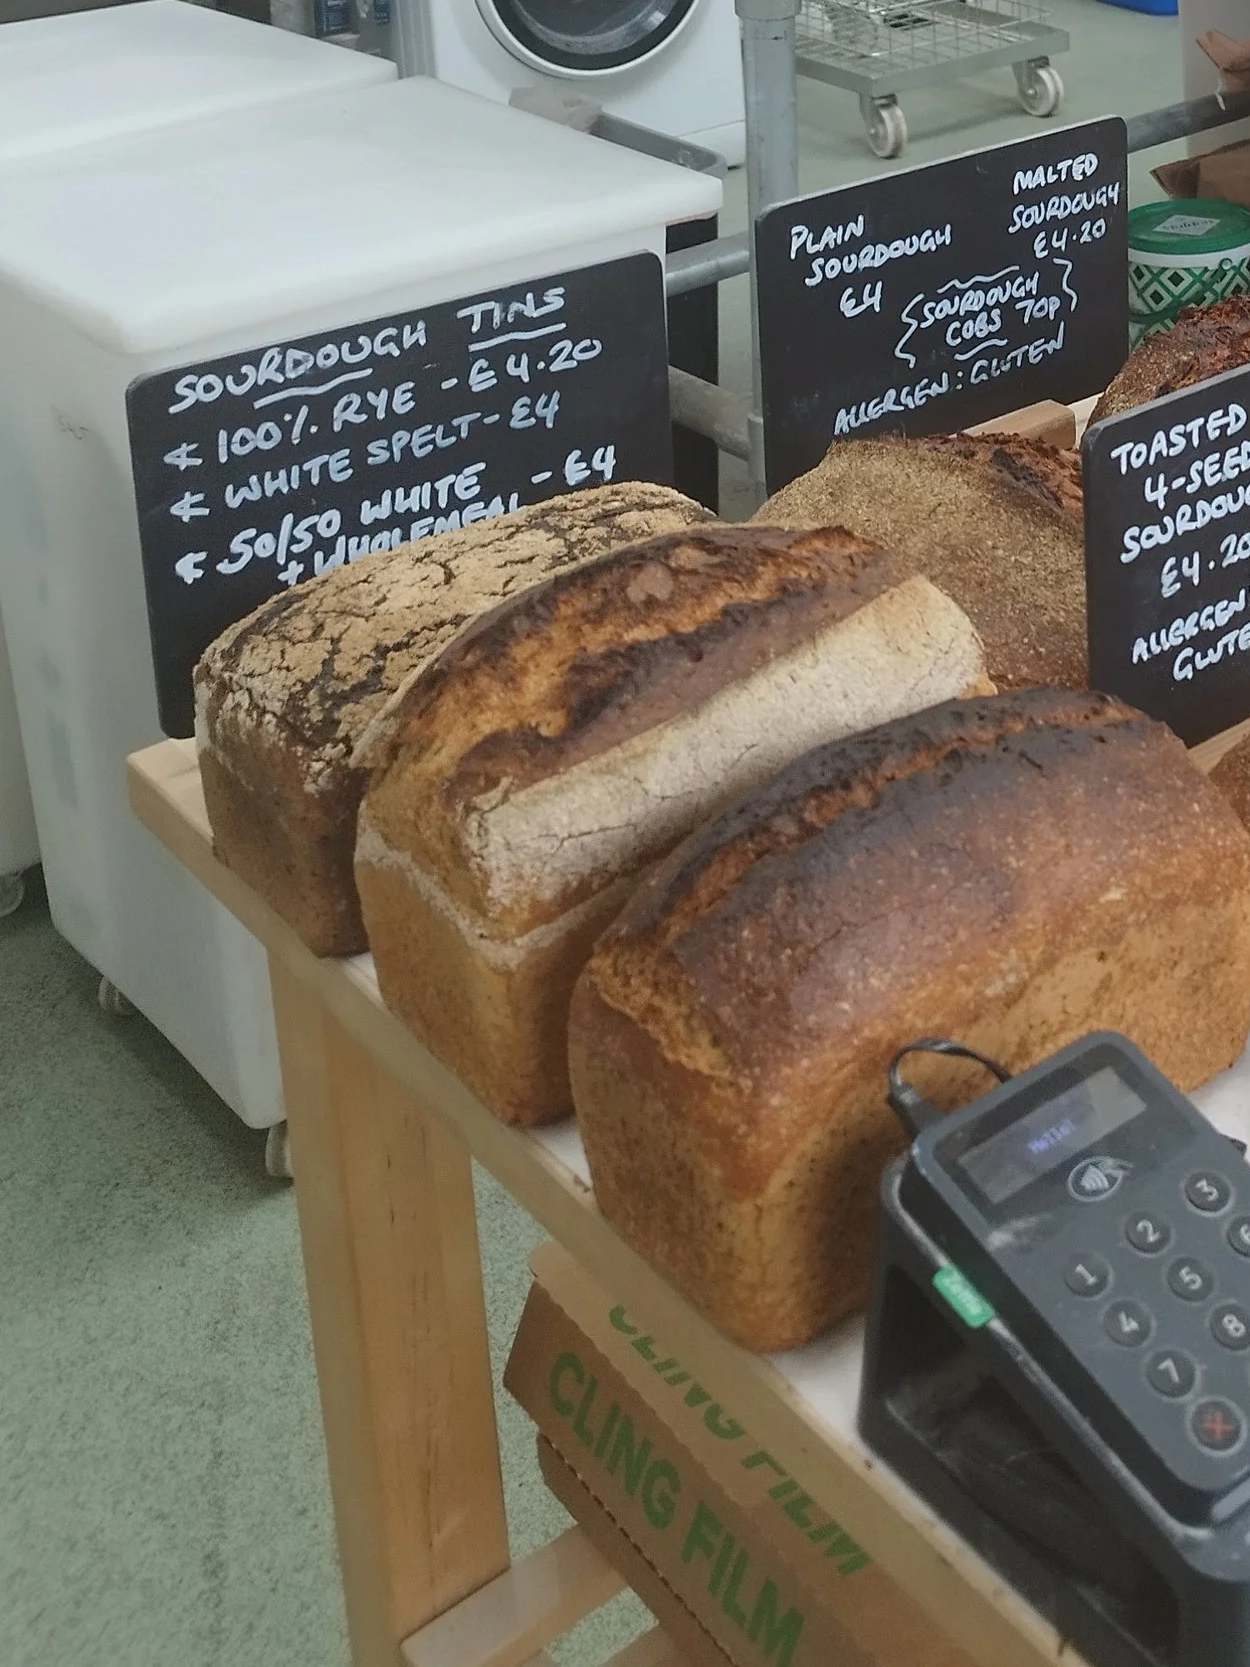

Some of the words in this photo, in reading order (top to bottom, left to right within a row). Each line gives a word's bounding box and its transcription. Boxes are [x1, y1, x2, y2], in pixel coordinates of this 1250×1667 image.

[1012, 151, 1099, 195] MALTED
[1008, 180, 1121, 234] SOURDOUGH
[789, 213, 866, 261] PLAIN
[804, 223, 952, 288] SOURDOUGH
[1032, 217, 1106, 259] £4.20
[838, 280, 884, 319] £4
[920, 270, 1041, 329] SOURDOUGH
[169, 318, 428, 416] SOURDOUGH
[456, 286, 567, 336] TINS
[944, 308, 1002, 348] COBS
[969, 320, 1066, 386] GLUTEN
[216, 407, 320, 464] 100%
[332, 381, 417, 434] RYE
[1110, 402, 1248, 476] TOASTED
[223, 448, 355, 511] WHITE
[216, 507, 342, 576] 50/50
[359, 460, 488, 527] WHITE
[1195, 1178, 1220, 1202] 3
[1136, 1218, 1161, 1244] 2
[1074, 1262, 1098, 1286] 1
[1178, 1265, 1203, 1290] 5
[1118, 1310, 1140, 1334] 4
[1221, 1313, 1247, 1337] 8
[1156, 1356, 1180, 1384] 7
[548, 1351, 682, 1530] CLING
[680, 1499, 806, 1667] FILM
